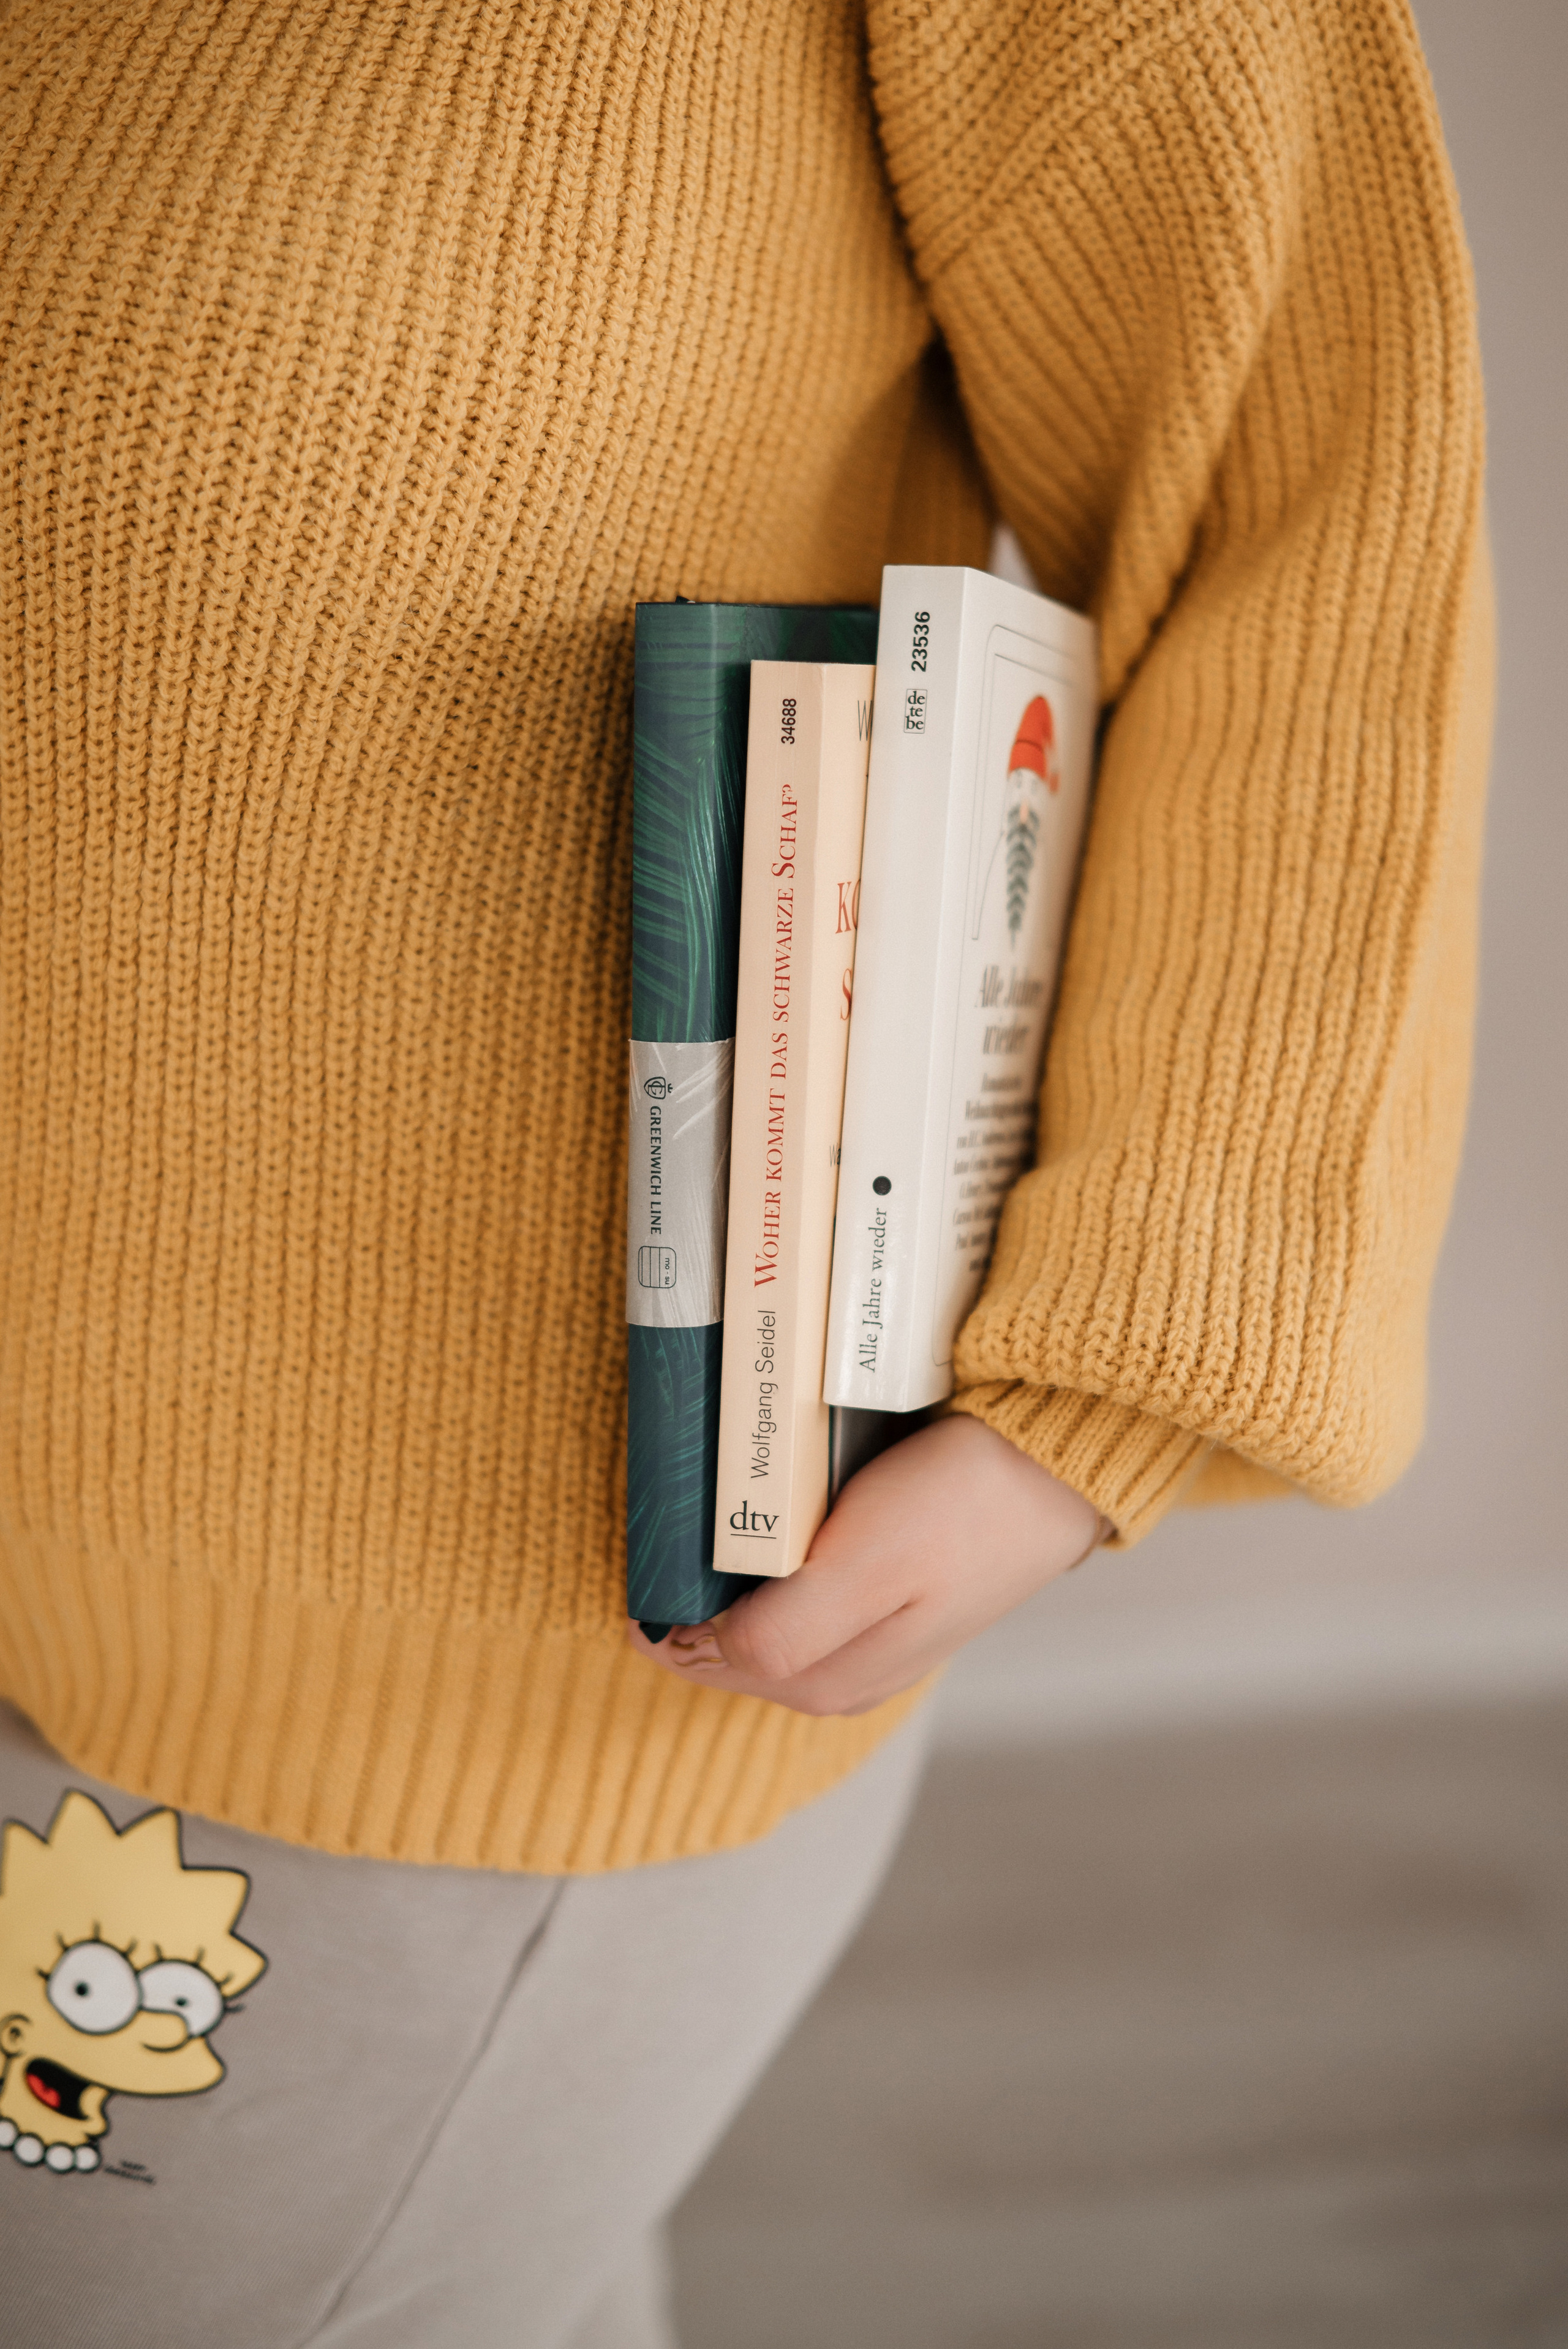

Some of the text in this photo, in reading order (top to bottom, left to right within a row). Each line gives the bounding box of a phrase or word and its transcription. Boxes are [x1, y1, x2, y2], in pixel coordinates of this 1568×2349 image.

[911, 611, 930, 673] 23536
[907, 690, 925, 705] de
[910, 706, 923, 717] te
[780, 698, 797, 744] 34688
[905, 715, 924, 730] be
[754, 784, 797, 1287] WOHER KOMMT DAS SCHWARZE SCHAF?
[650, 1105, 662, 1235] GREENWICH LINE
[665, 1257, 670, 1270] mo
[665, 1276, 670, 1285] su
[859, 1207, 888, 1374] Alle Jahre wieder
[750, 1309, 778, 1479] Wolfgang Seidel
[729, 1500, 780, 1533] dtv
